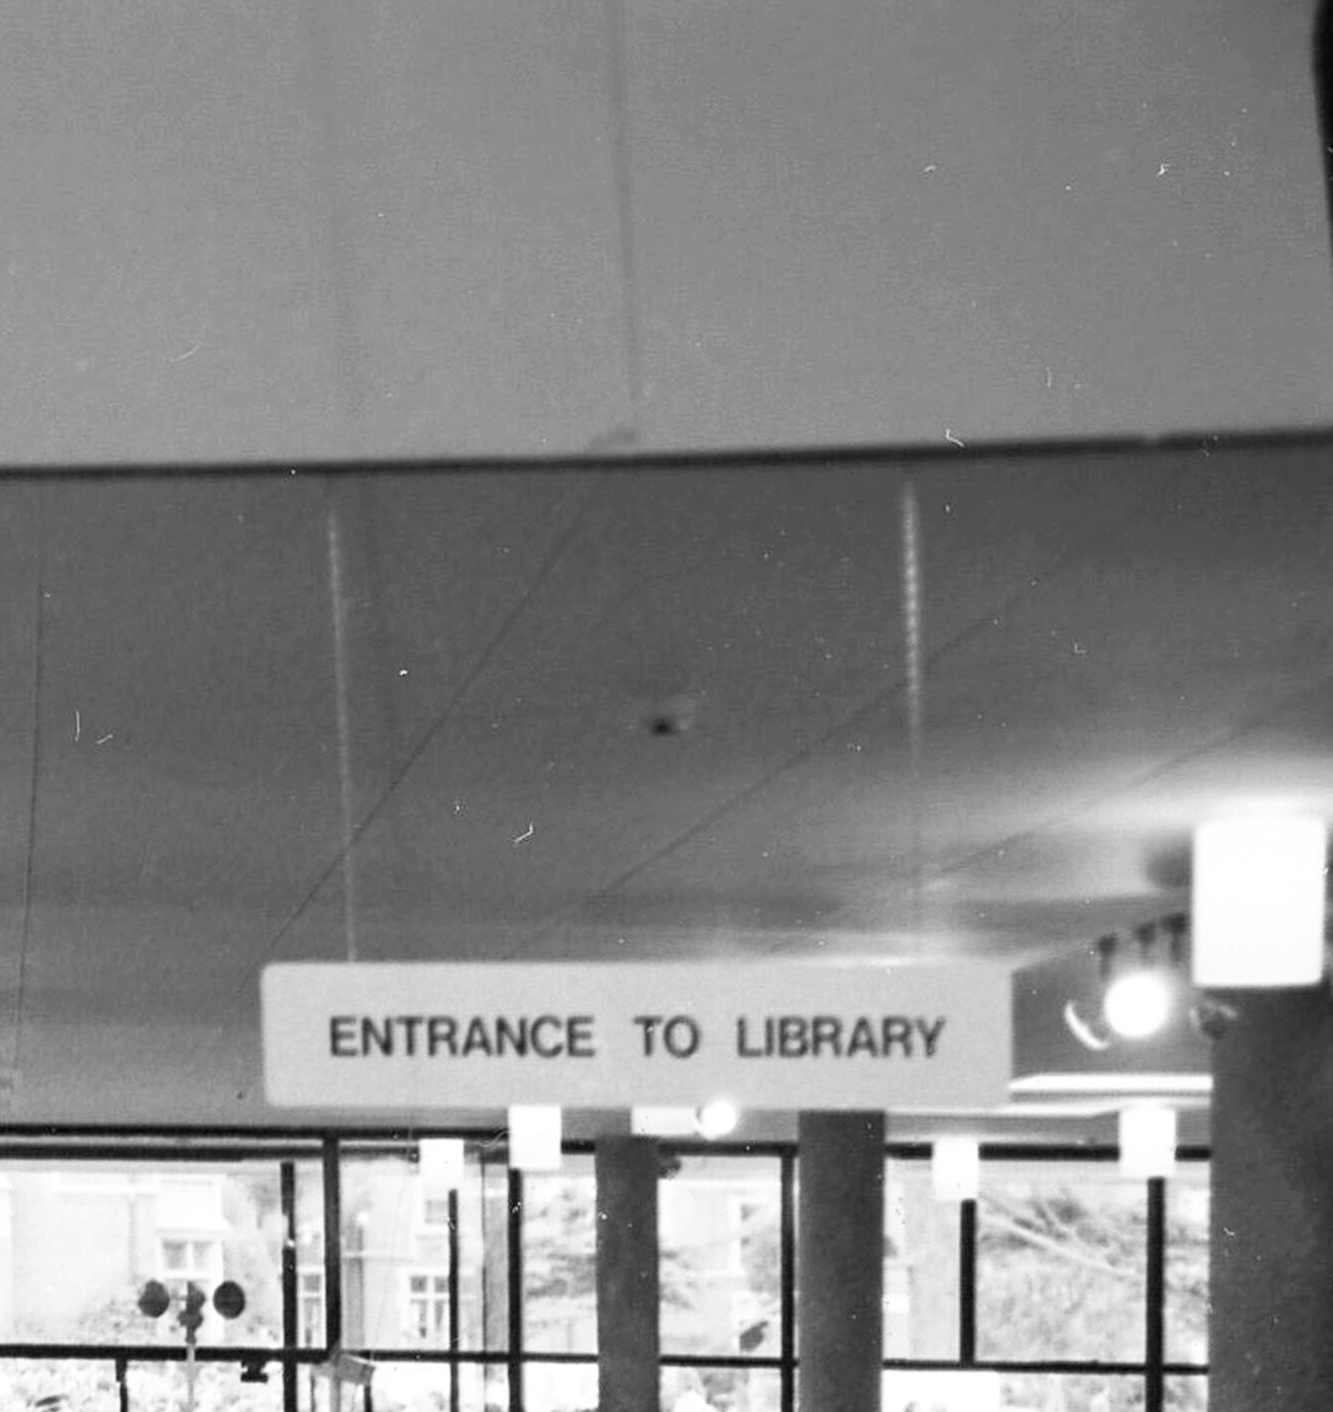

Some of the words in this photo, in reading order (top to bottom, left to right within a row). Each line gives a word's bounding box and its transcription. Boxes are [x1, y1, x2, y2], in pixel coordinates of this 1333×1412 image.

[329, 1015, 596, 1058] ENTRANCE
[634, 1015, 702, 1059] TO
[738, 1015, 947, 1059] LIBRARY
